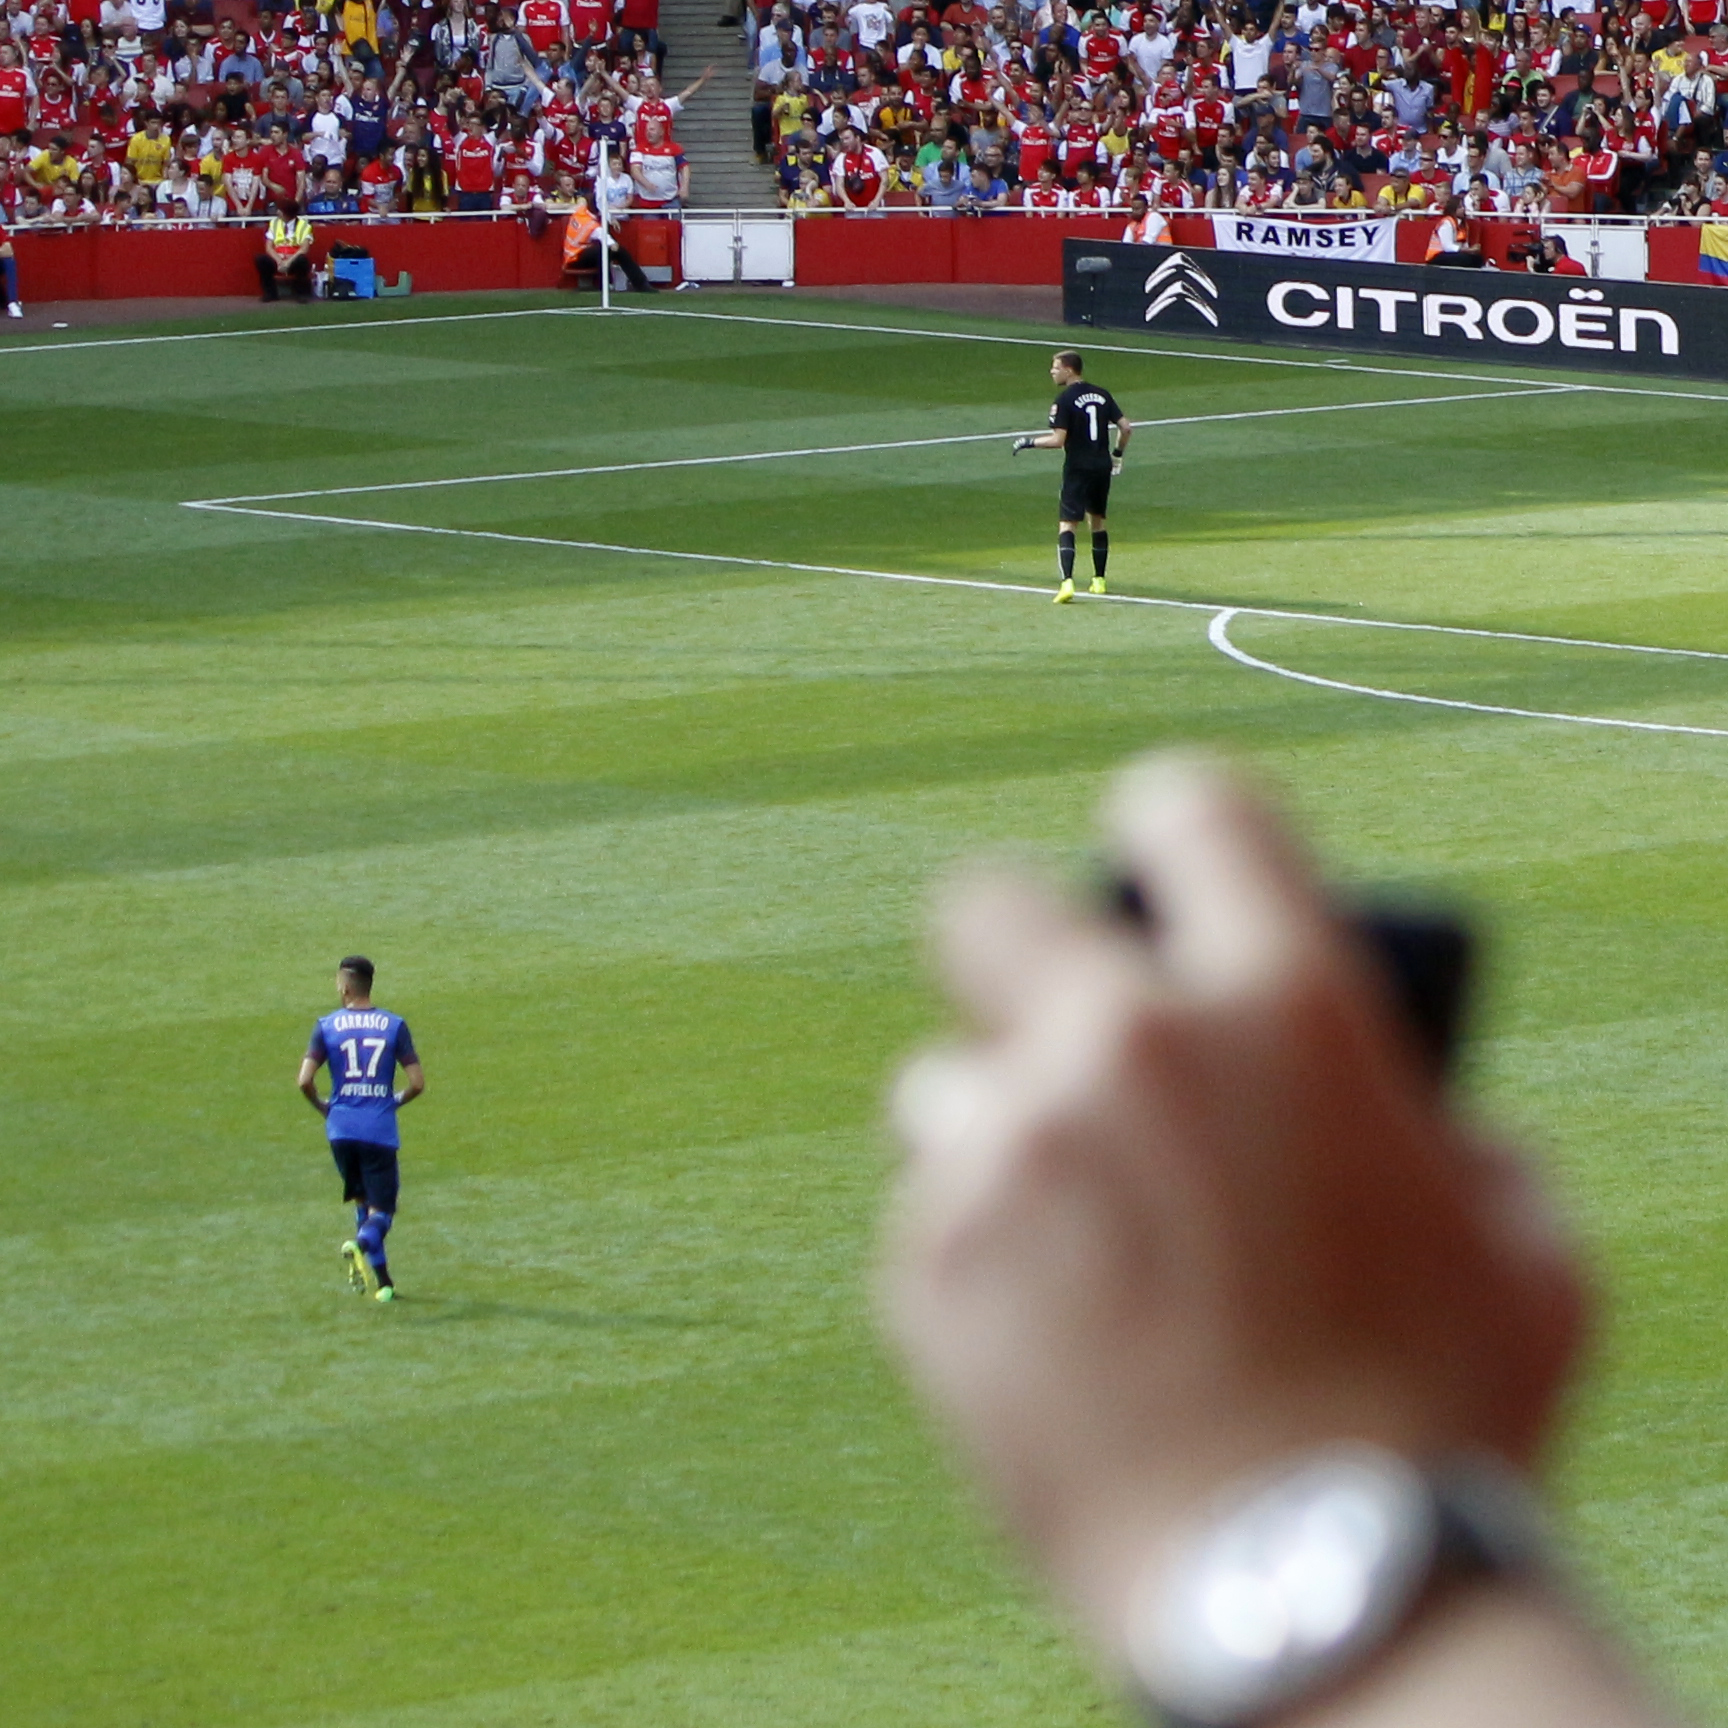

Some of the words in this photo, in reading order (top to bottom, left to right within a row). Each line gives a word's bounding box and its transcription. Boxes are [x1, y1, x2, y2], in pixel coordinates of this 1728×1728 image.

[1235, 221, 1382, 248] RAMSEY
[1085, 404, 1099, 442] 1
[334, 1013, 390, 1032] CARRASCO
[340, 1037, 387, 1079] 17
